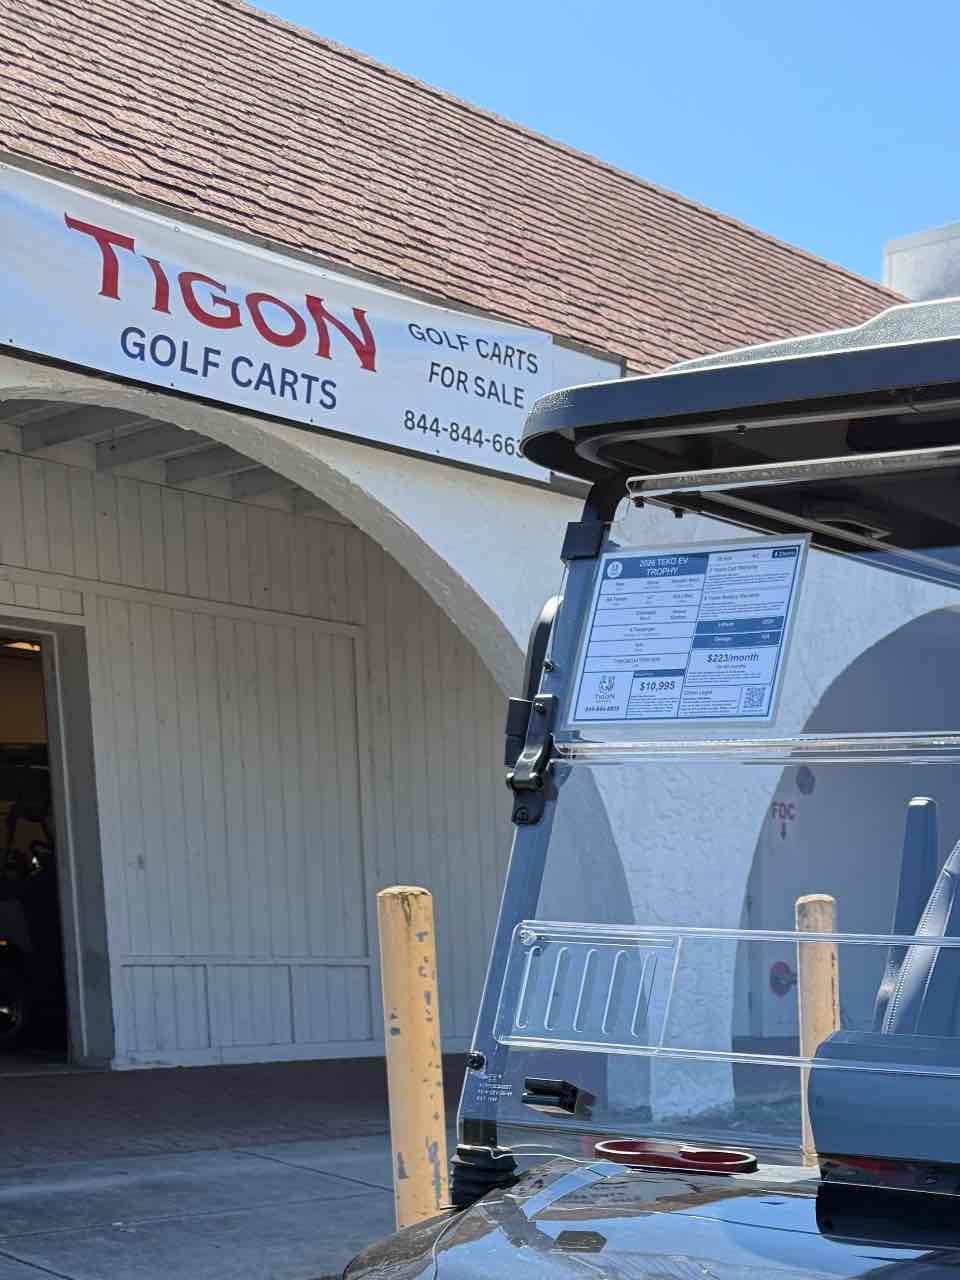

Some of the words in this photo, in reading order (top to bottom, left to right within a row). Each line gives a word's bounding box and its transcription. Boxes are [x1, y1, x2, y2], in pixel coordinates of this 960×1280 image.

[64, 211, 377, 373] TIGON
[120, 326, 222, 378] GOLF
[231, 355, 338, 410] CARTS
[408, 323, 469, 352] GOLF
[476, 338, 539, 374] CARTS
[429, 361, 469, 394] FOR
[474, 375, 525, 409] SALE
[647, 567, 680, 577] TROPHY
[705, 652, 760, 664] $223/month
[639, 680, 676, 692] $10,995
